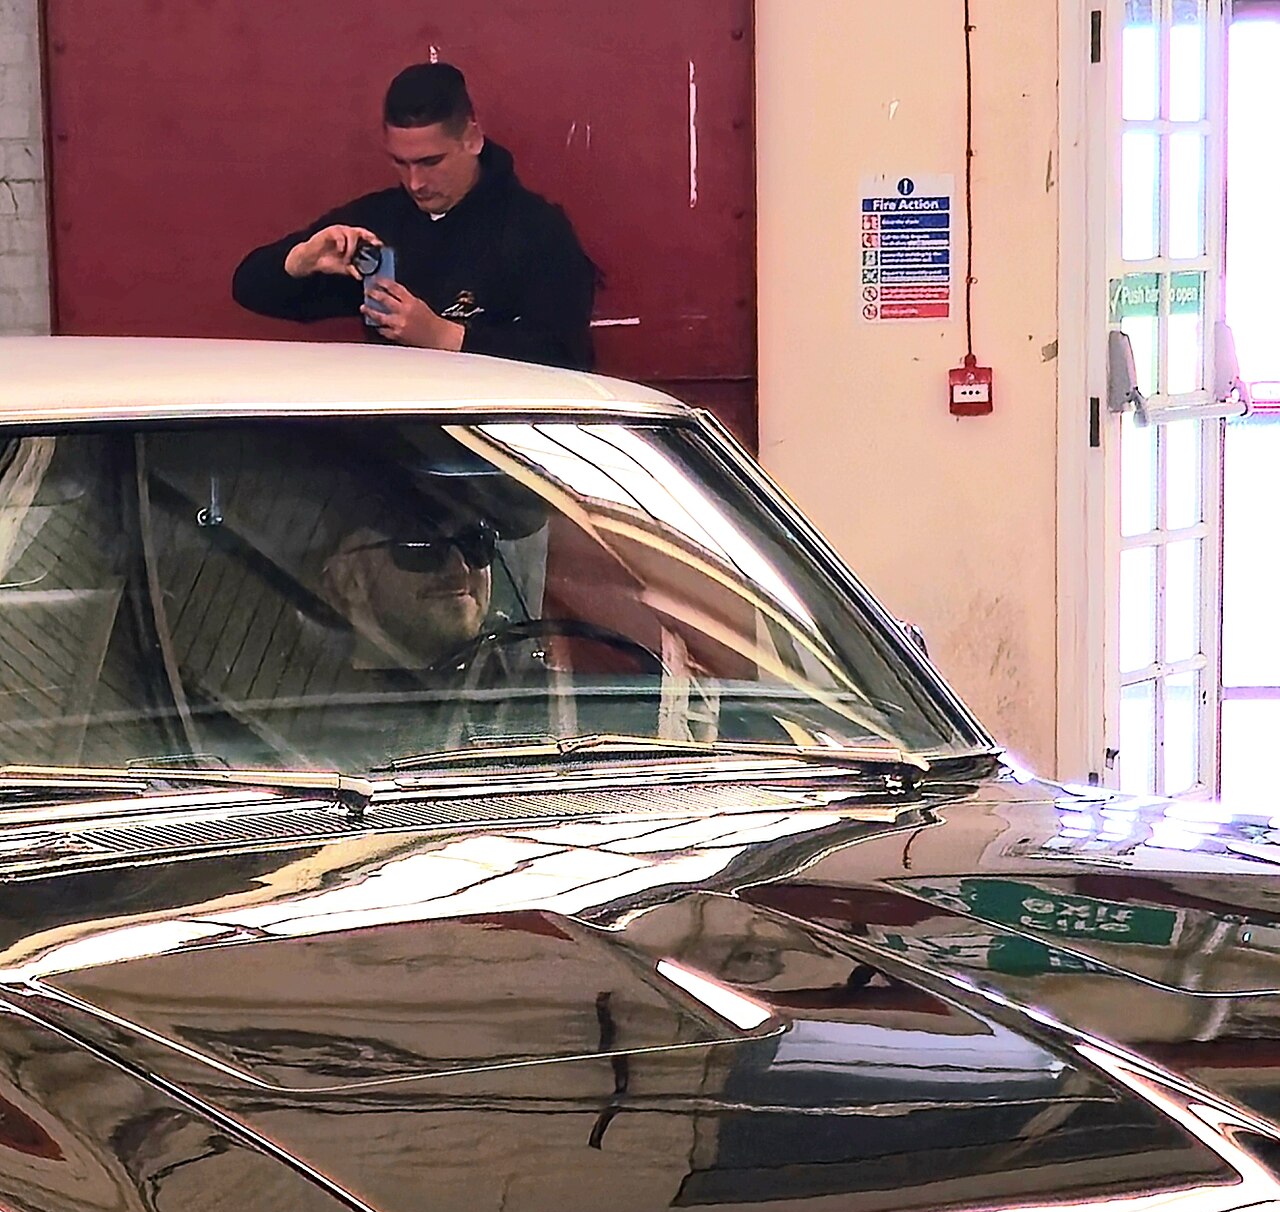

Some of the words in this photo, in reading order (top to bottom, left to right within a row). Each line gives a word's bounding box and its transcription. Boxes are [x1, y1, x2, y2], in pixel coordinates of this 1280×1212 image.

[872, 199, 897, 211] Fire
[898, 198, 940, 210] Action
[1121, 285, 1145, 306] Push
[1176, 287, 1199, 307] open
